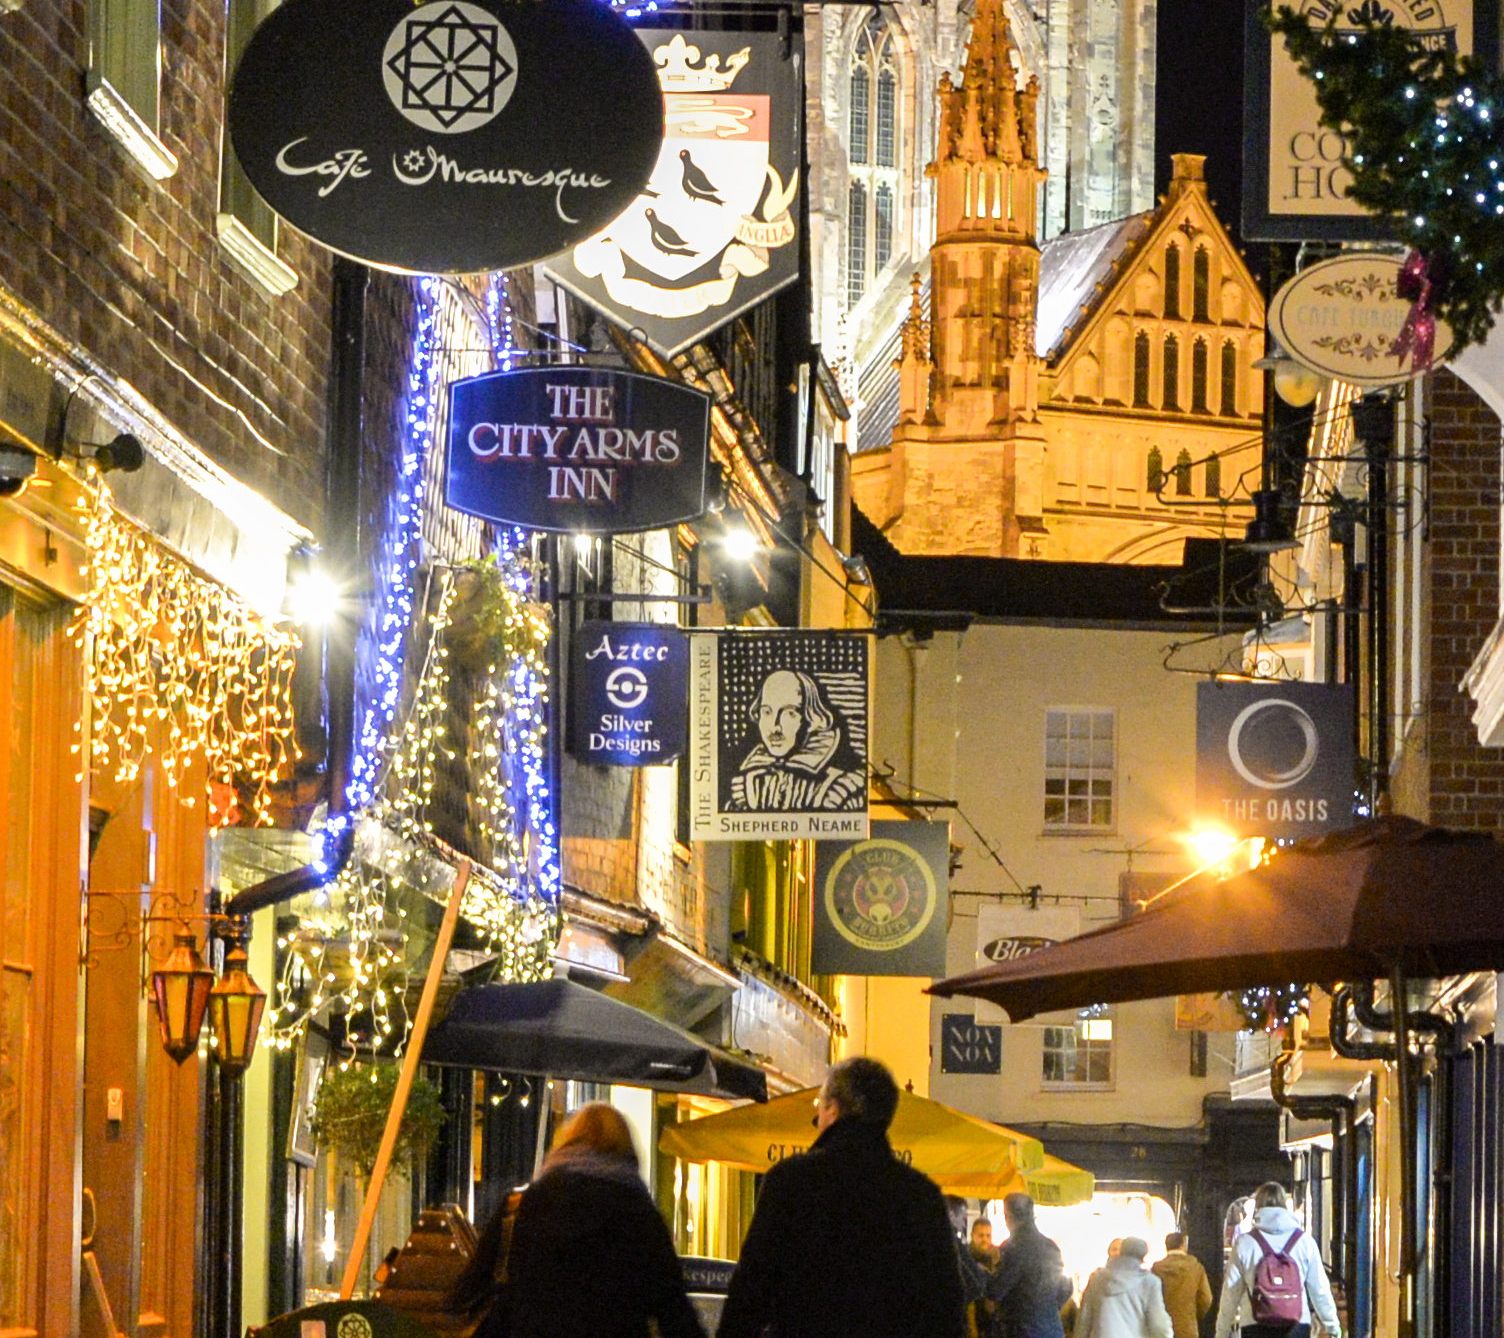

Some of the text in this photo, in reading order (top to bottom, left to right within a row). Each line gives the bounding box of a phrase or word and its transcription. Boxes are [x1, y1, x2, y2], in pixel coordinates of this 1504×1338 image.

[276, 136, 612, 224] Café Mauresque
[546, 384, 615, 423] THE
[467, 423, 680, 462] CITY ARMS
[547, 465, 616, 502] INN
[585, 634, 669, 661] Aztec
[600, 714, 652, 733] Silver
[695, 645, 713, 832] THE SHAKESPEARE
[589, 733, 661, 756] Designs
[720, 815, 862, 835] SHEPHERD NEAME
[1221, 799, 1328, 822] THE OASIS
